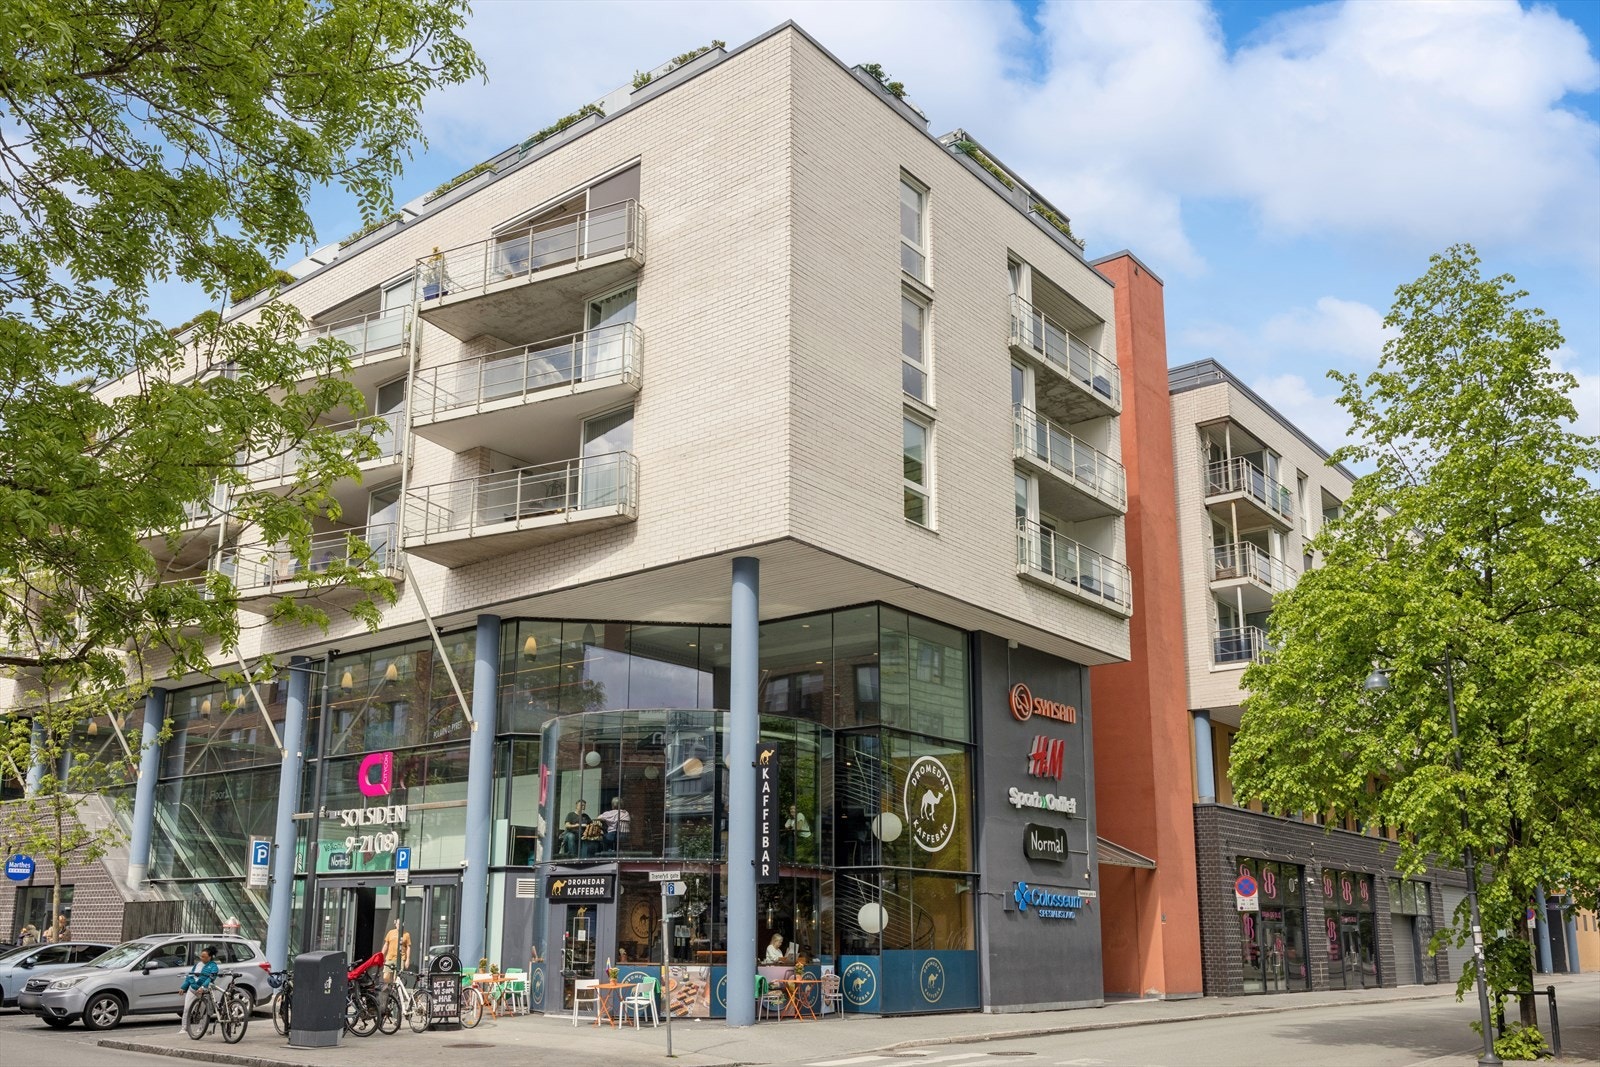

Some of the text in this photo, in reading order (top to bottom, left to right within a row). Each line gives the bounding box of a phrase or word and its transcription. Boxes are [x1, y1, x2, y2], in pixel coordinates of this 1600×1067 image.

[911, 764, 949, 792] DROMEDAR
[1009, 787, 1077, 814] Sport Outlet
[341, 805, 407, 827] SOLSIDEN
[762, 767, 770, 876] KAFFEBAR
[913, 819, 948, 843] KAFFEBAR
[1031, 830, 1064, 853] Normal
[257, 849, 267, 863] P
[399, 851, 407, 867] P
[567, 887, 605, 895] KAFFEBAR
[1031, 888, 1082, 909] Colosseum
